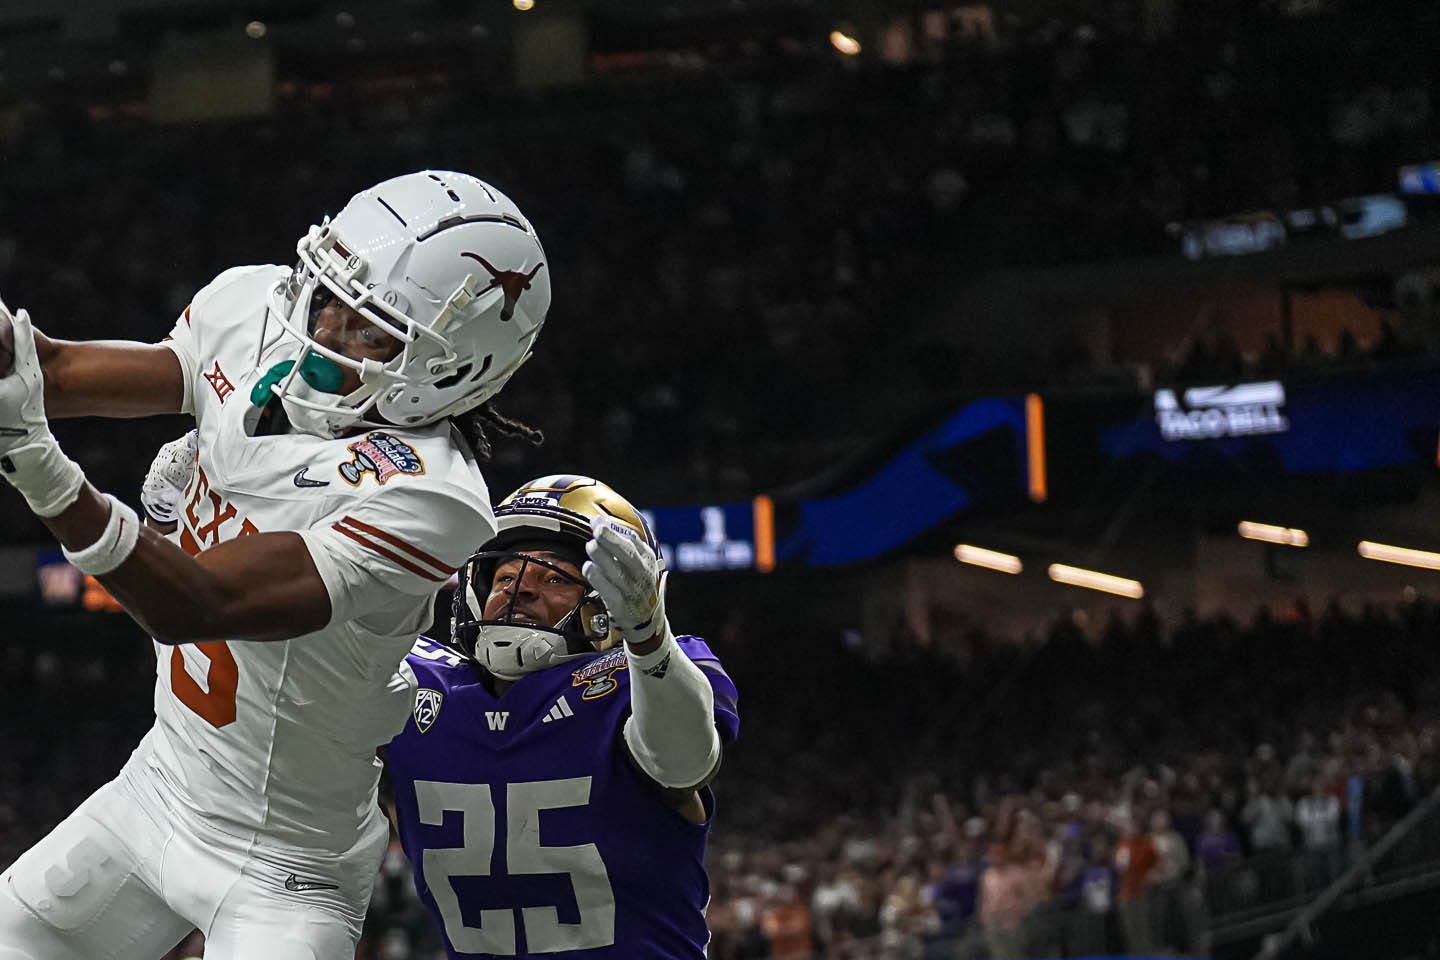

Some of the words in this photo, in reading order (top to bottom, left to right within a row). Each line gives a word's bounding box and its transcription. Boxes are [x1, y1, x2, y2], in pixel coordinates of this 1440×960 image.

[415, 690, 441, 717] PAC
[418, 707, 432, 725] 12
[485, 711, 510, 731] W
[413, 775, 616, 956] 25
